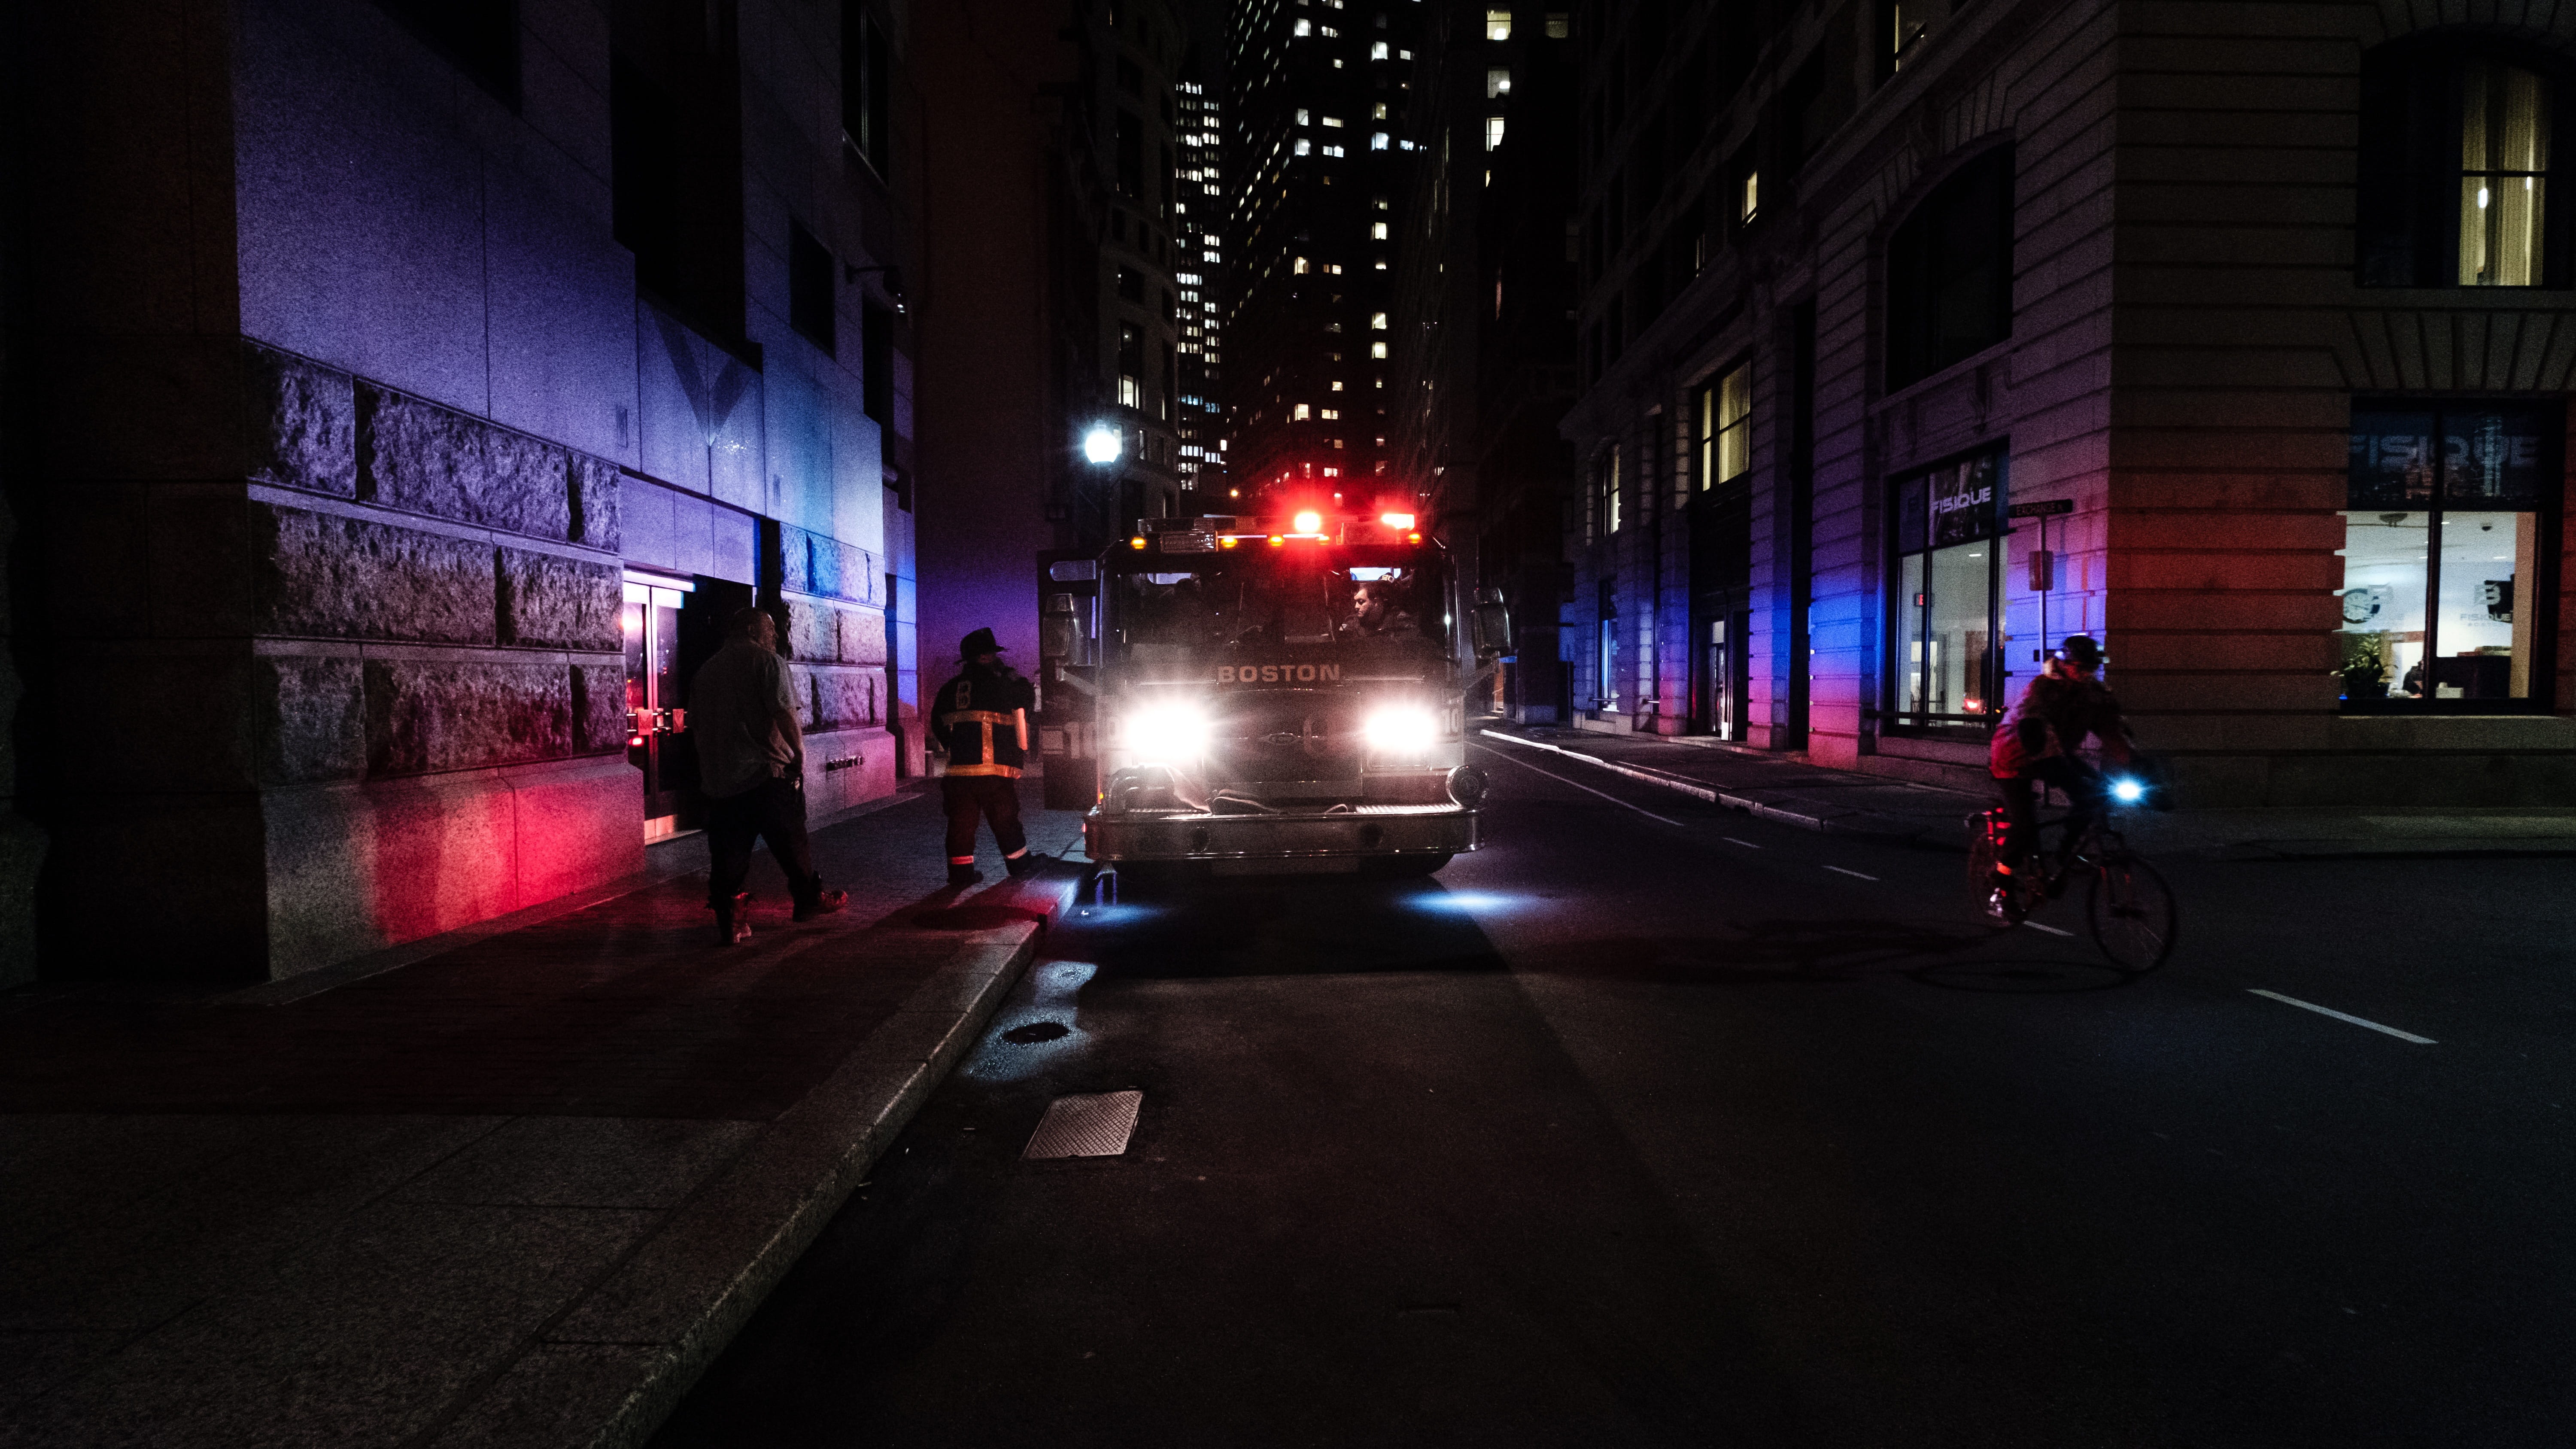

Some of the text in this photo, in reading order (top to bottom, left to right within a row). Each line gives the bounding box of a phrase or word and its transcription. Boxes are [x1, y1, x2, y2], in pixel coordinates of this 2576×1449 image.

[1930, 486, 1991, 514] FISIQUE
[1218, 664, 1340, 682] BOSTON
[956, 680, 972, 710] B
